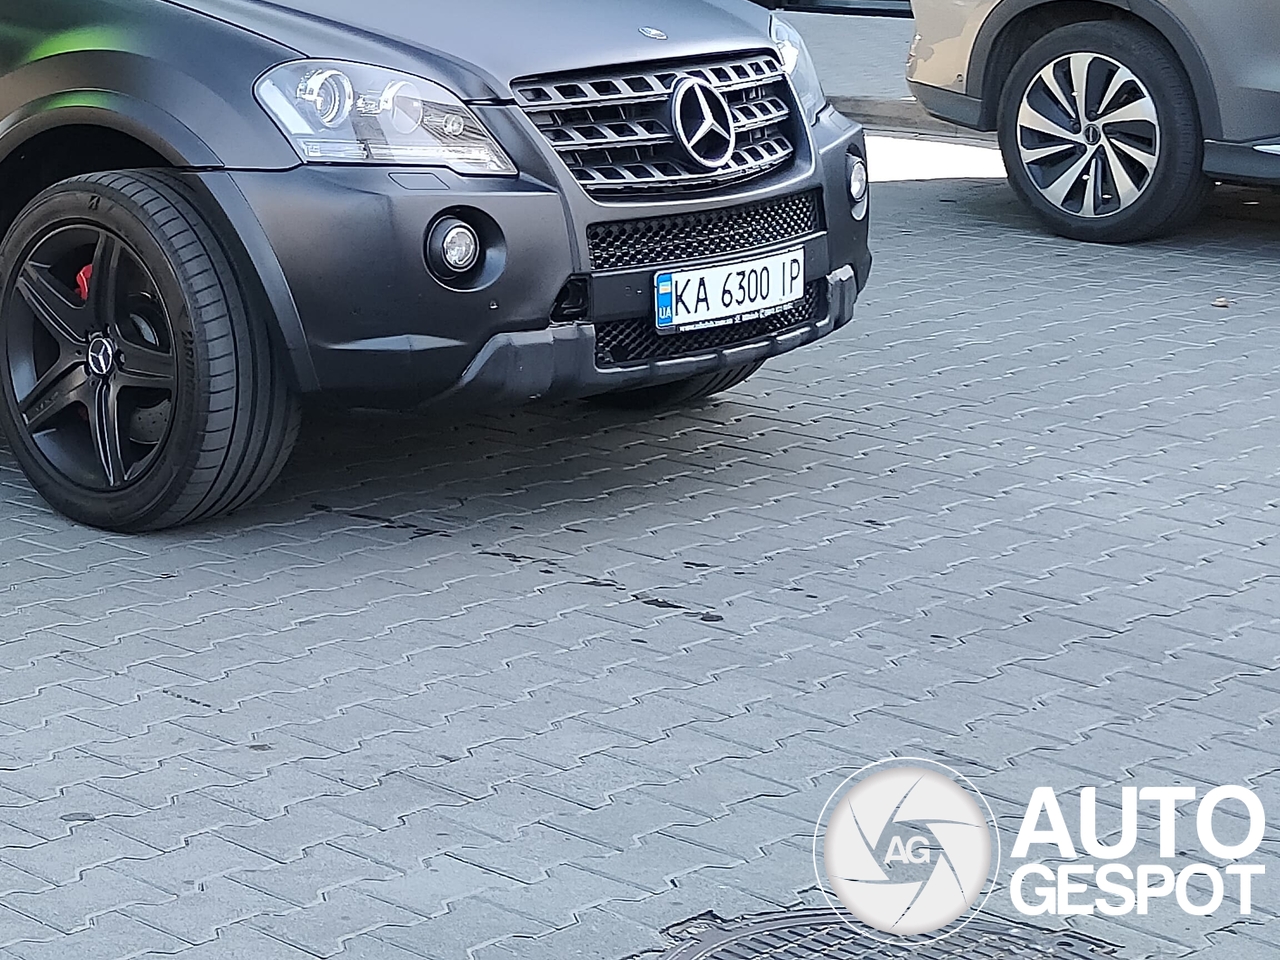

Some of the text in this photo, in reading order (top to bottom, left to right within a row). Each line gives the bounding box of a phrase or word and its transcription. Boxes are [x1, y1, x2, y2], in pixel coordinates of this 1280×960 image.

[675, 277, 710, 317] KA
[721, 266, 770, 309] 6300
[782, 258, 801, 297] IP
[659, 306, 671, 319] UA
